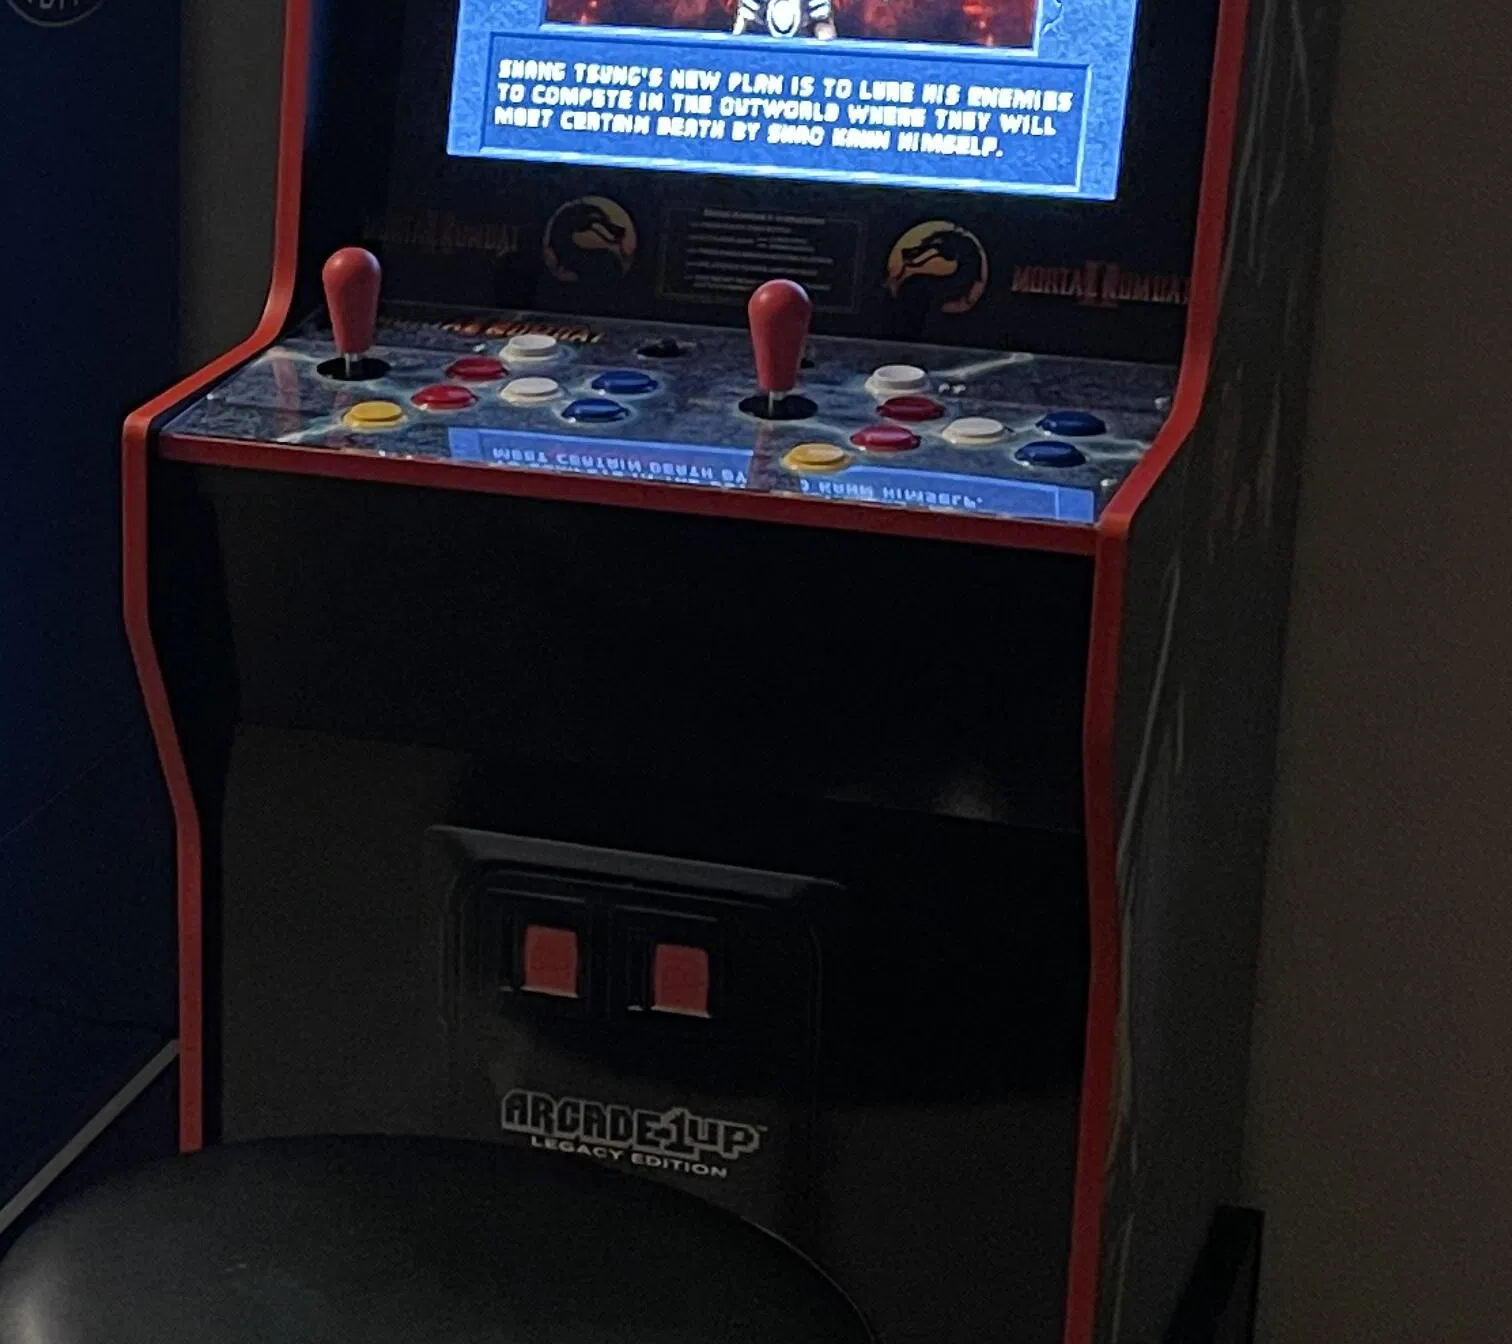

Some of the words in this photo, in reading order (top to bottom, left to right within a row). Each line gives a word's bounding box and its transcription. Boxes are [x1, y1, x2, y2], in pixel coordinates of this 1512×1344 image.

[497, 82, 525, 104] TO
[532, 85, 633, 110] COMPETE
[639, 92, 663, 112] IN
[672, 93, 712, 115] THE
[719, 96, 840, 123] OUTWORLD
[848, 104, 927, 128] WHERE
[935, 108, 991, 131] THEY
[999, 113, 1057, 136] WILL
[670, 68, 721, 91] NEW
[728, 71, 784, 96] PLAN
[790, 76, 815, 97] IS
[823, 78, 853, 99] TO
[859, 80, 915, 103] LURE
[922, 83, 961, 105] HIS
[967, 86, 1074, 112] ENEMIES
[559, 110, 650, 135] CERTAIN
[656, 116, 726, 140] DEATH
[731, 120, 761, 142] BY
[531, 1136, 624, 1160] LEGACY
[631, 1153, 727, 1178] EDITION
